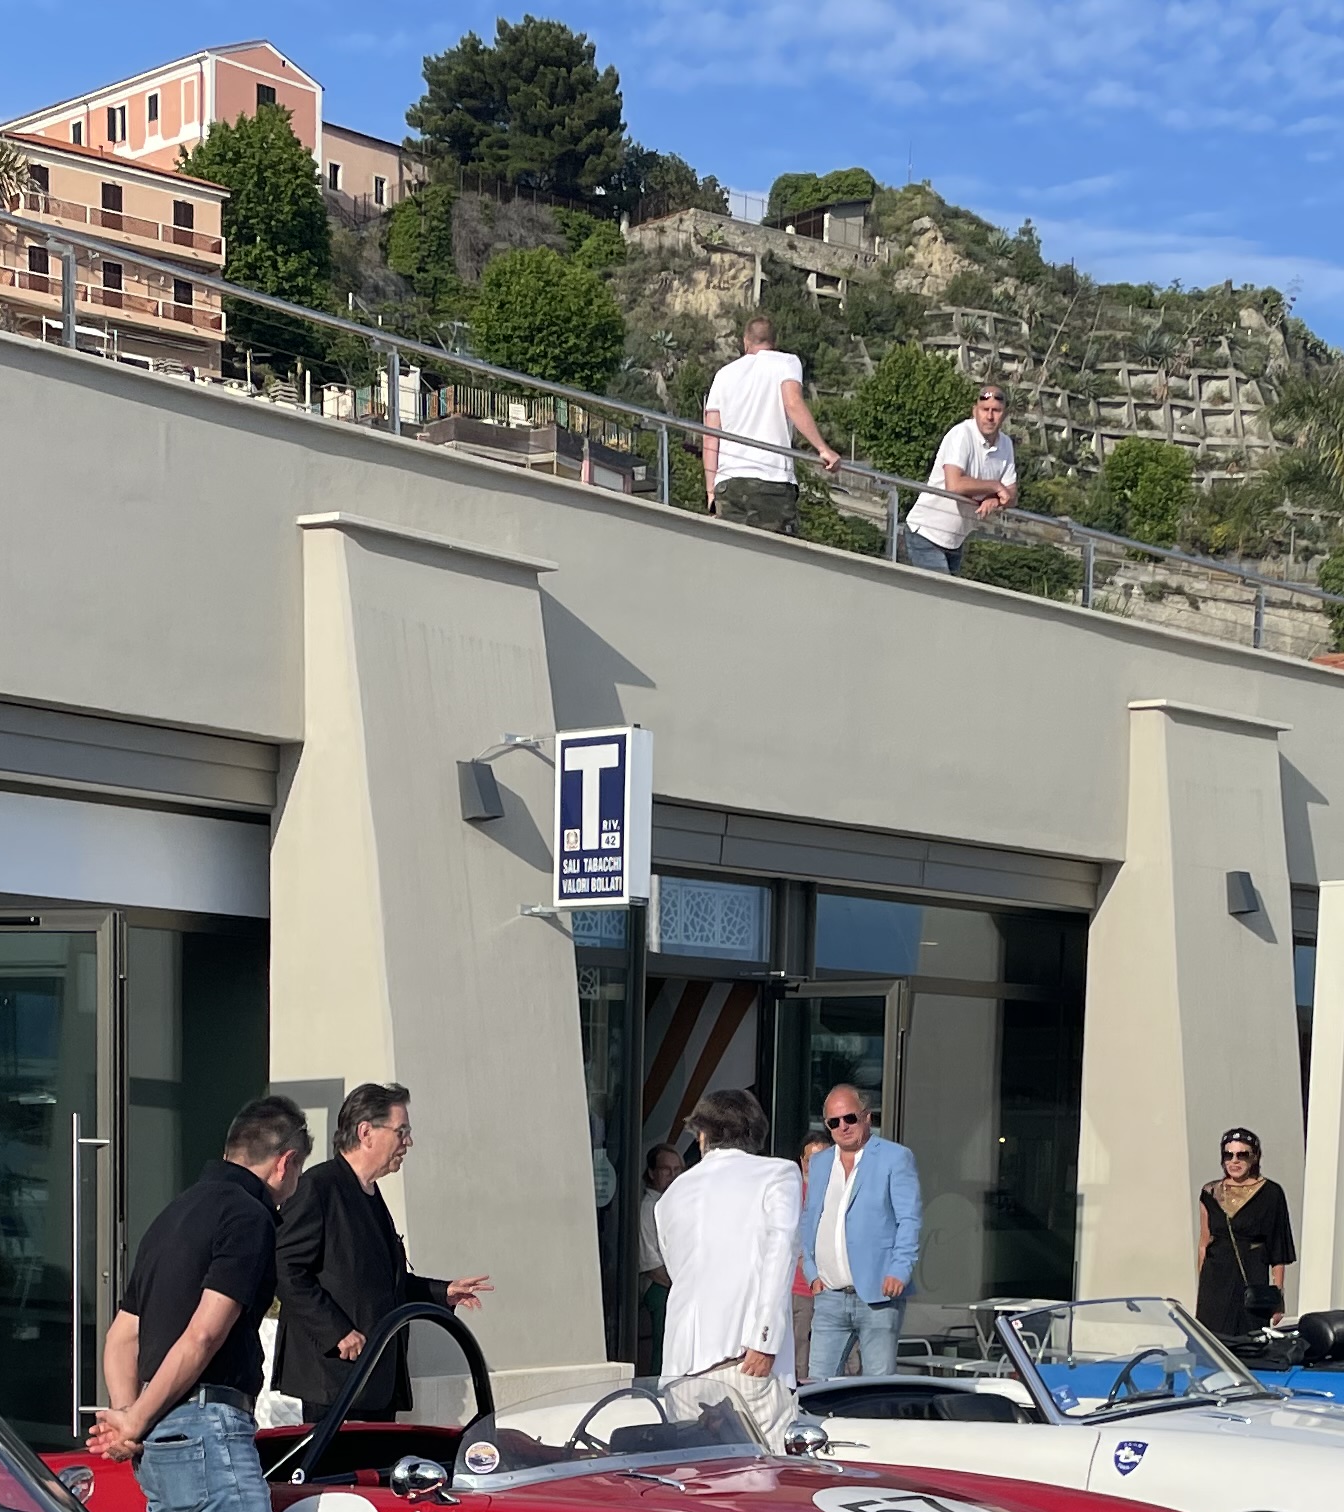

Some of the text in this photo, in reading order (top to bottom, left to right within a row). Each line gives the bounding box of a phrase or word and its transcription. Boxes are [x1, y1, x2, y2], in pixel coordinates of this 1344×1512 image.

[564, 743, 619, 850] T
[604, 835, 616, 846] 42
[562, 856, 622, 874] SALI TABACCHI
[562, 876, 623, 894] VALORI BOLLATI
